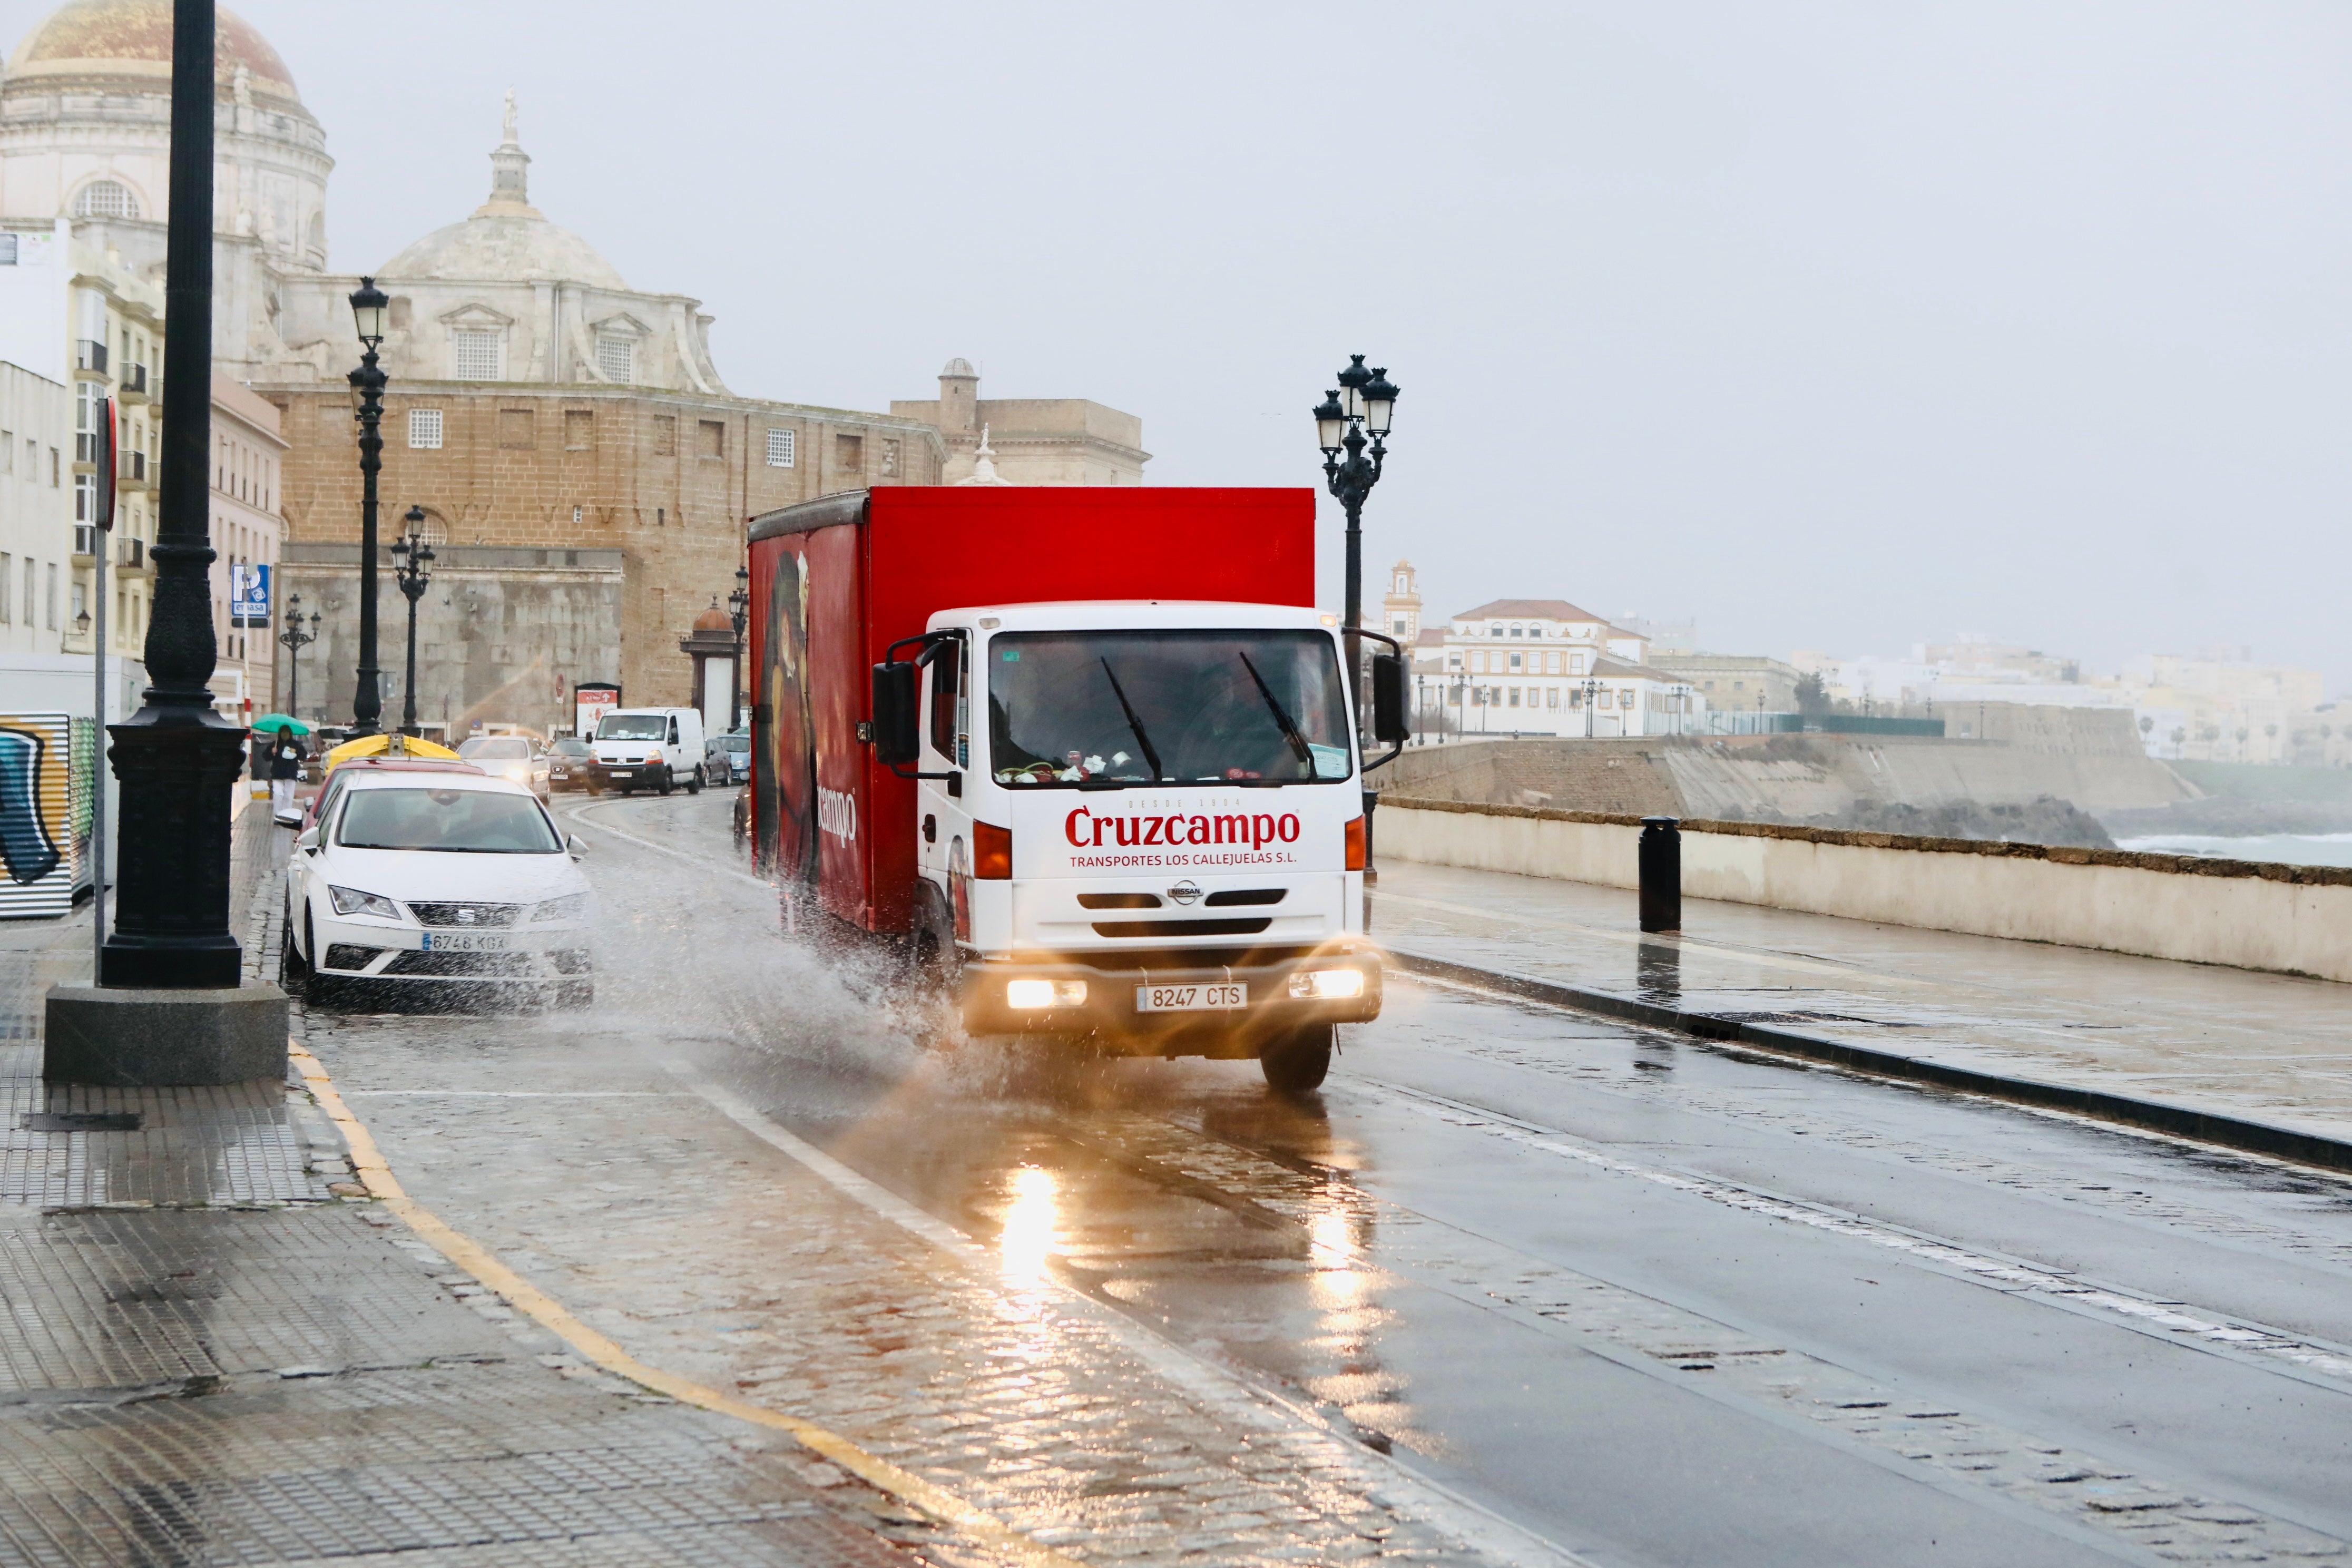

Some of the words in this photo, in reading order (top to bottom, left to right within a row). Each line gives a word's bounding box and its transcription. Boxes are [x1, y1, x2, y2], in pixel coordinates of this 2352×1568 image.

[1129, 799, 1182, 808] DESDE
[817, 785, 856, 848] campo
[1065, 805, 1300, 850] Cruzcampo
[1070, 856, 1162, 867] TRANSPORTES
[1166, 855, 1189, 865] LOS
[1193, 852, 1272, 866] CALLEJUELAS
[1276, 852, 1297, 863] S.L.
[1153, 988, 1197, 1007] 8247
[1207, 987, 1240, 1005] CTS
